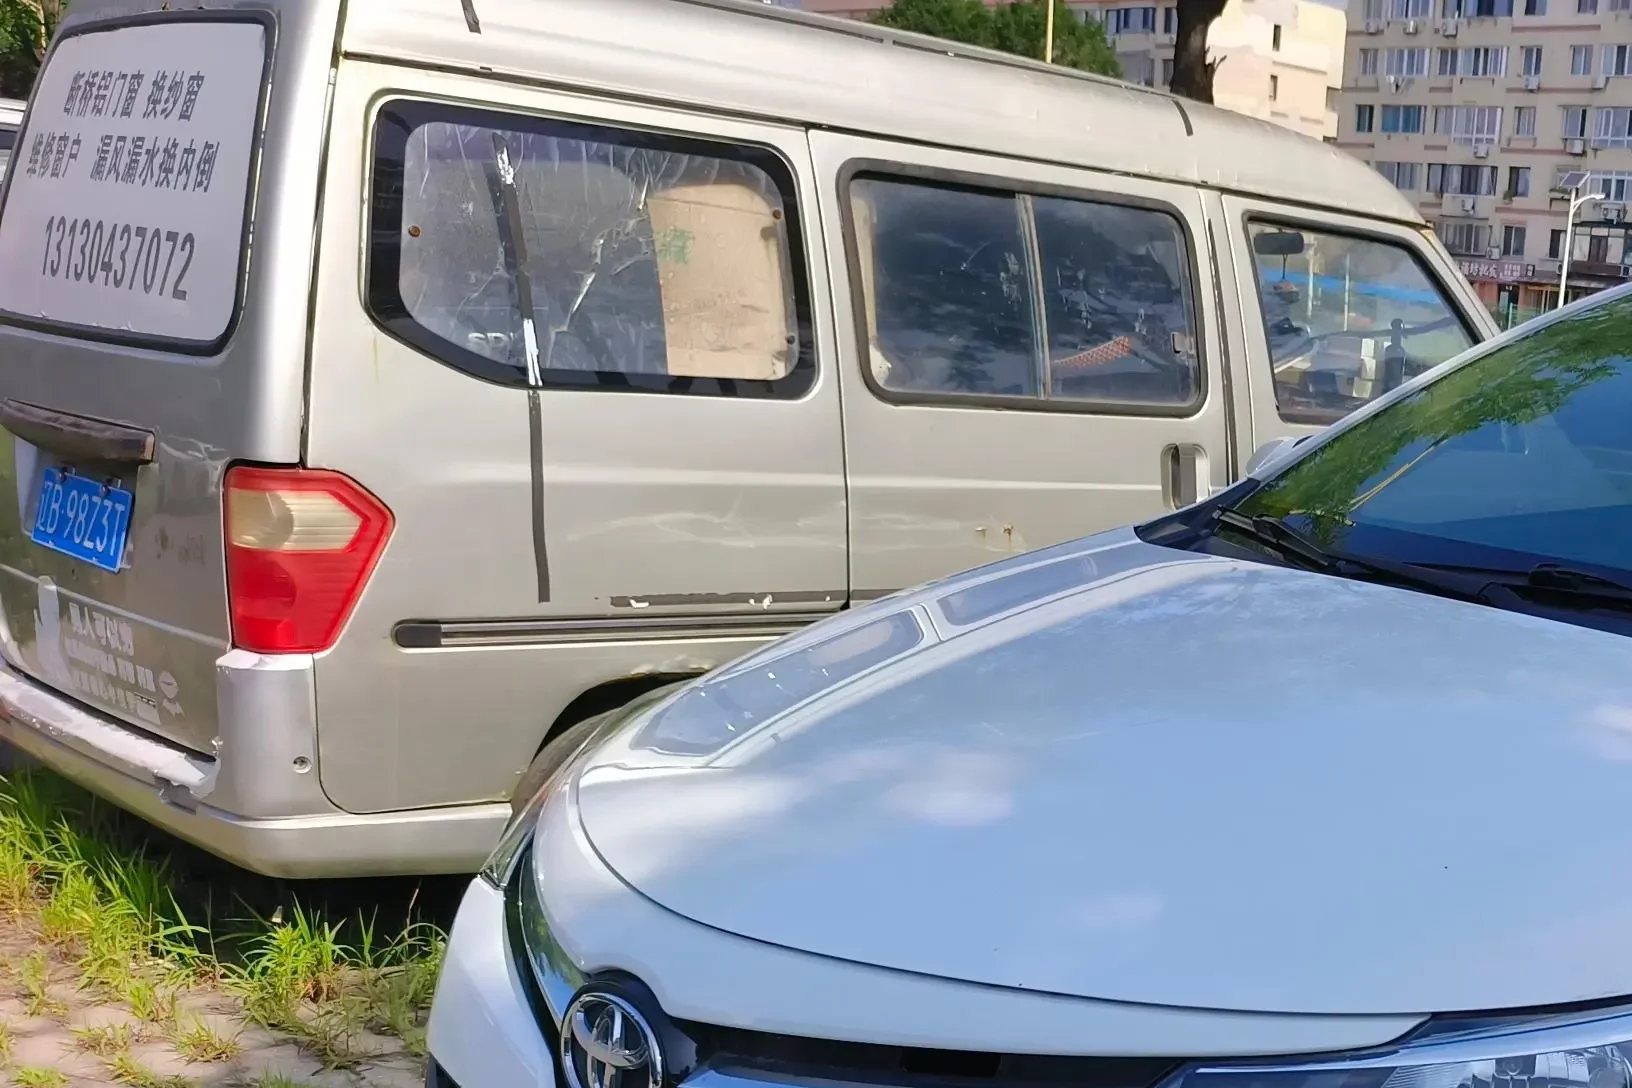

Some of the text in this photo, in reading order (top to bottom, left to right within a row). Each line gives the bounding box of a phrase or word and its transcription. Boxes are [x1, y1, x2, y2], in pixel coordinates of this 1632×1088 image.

[63, 69, 206, 123] 断桥铝门窗 换纱窗
[26, 131, 220, 193] 维修窗户 漏风漏水换内倒
[41, 215, 196, 302] 13130437072
